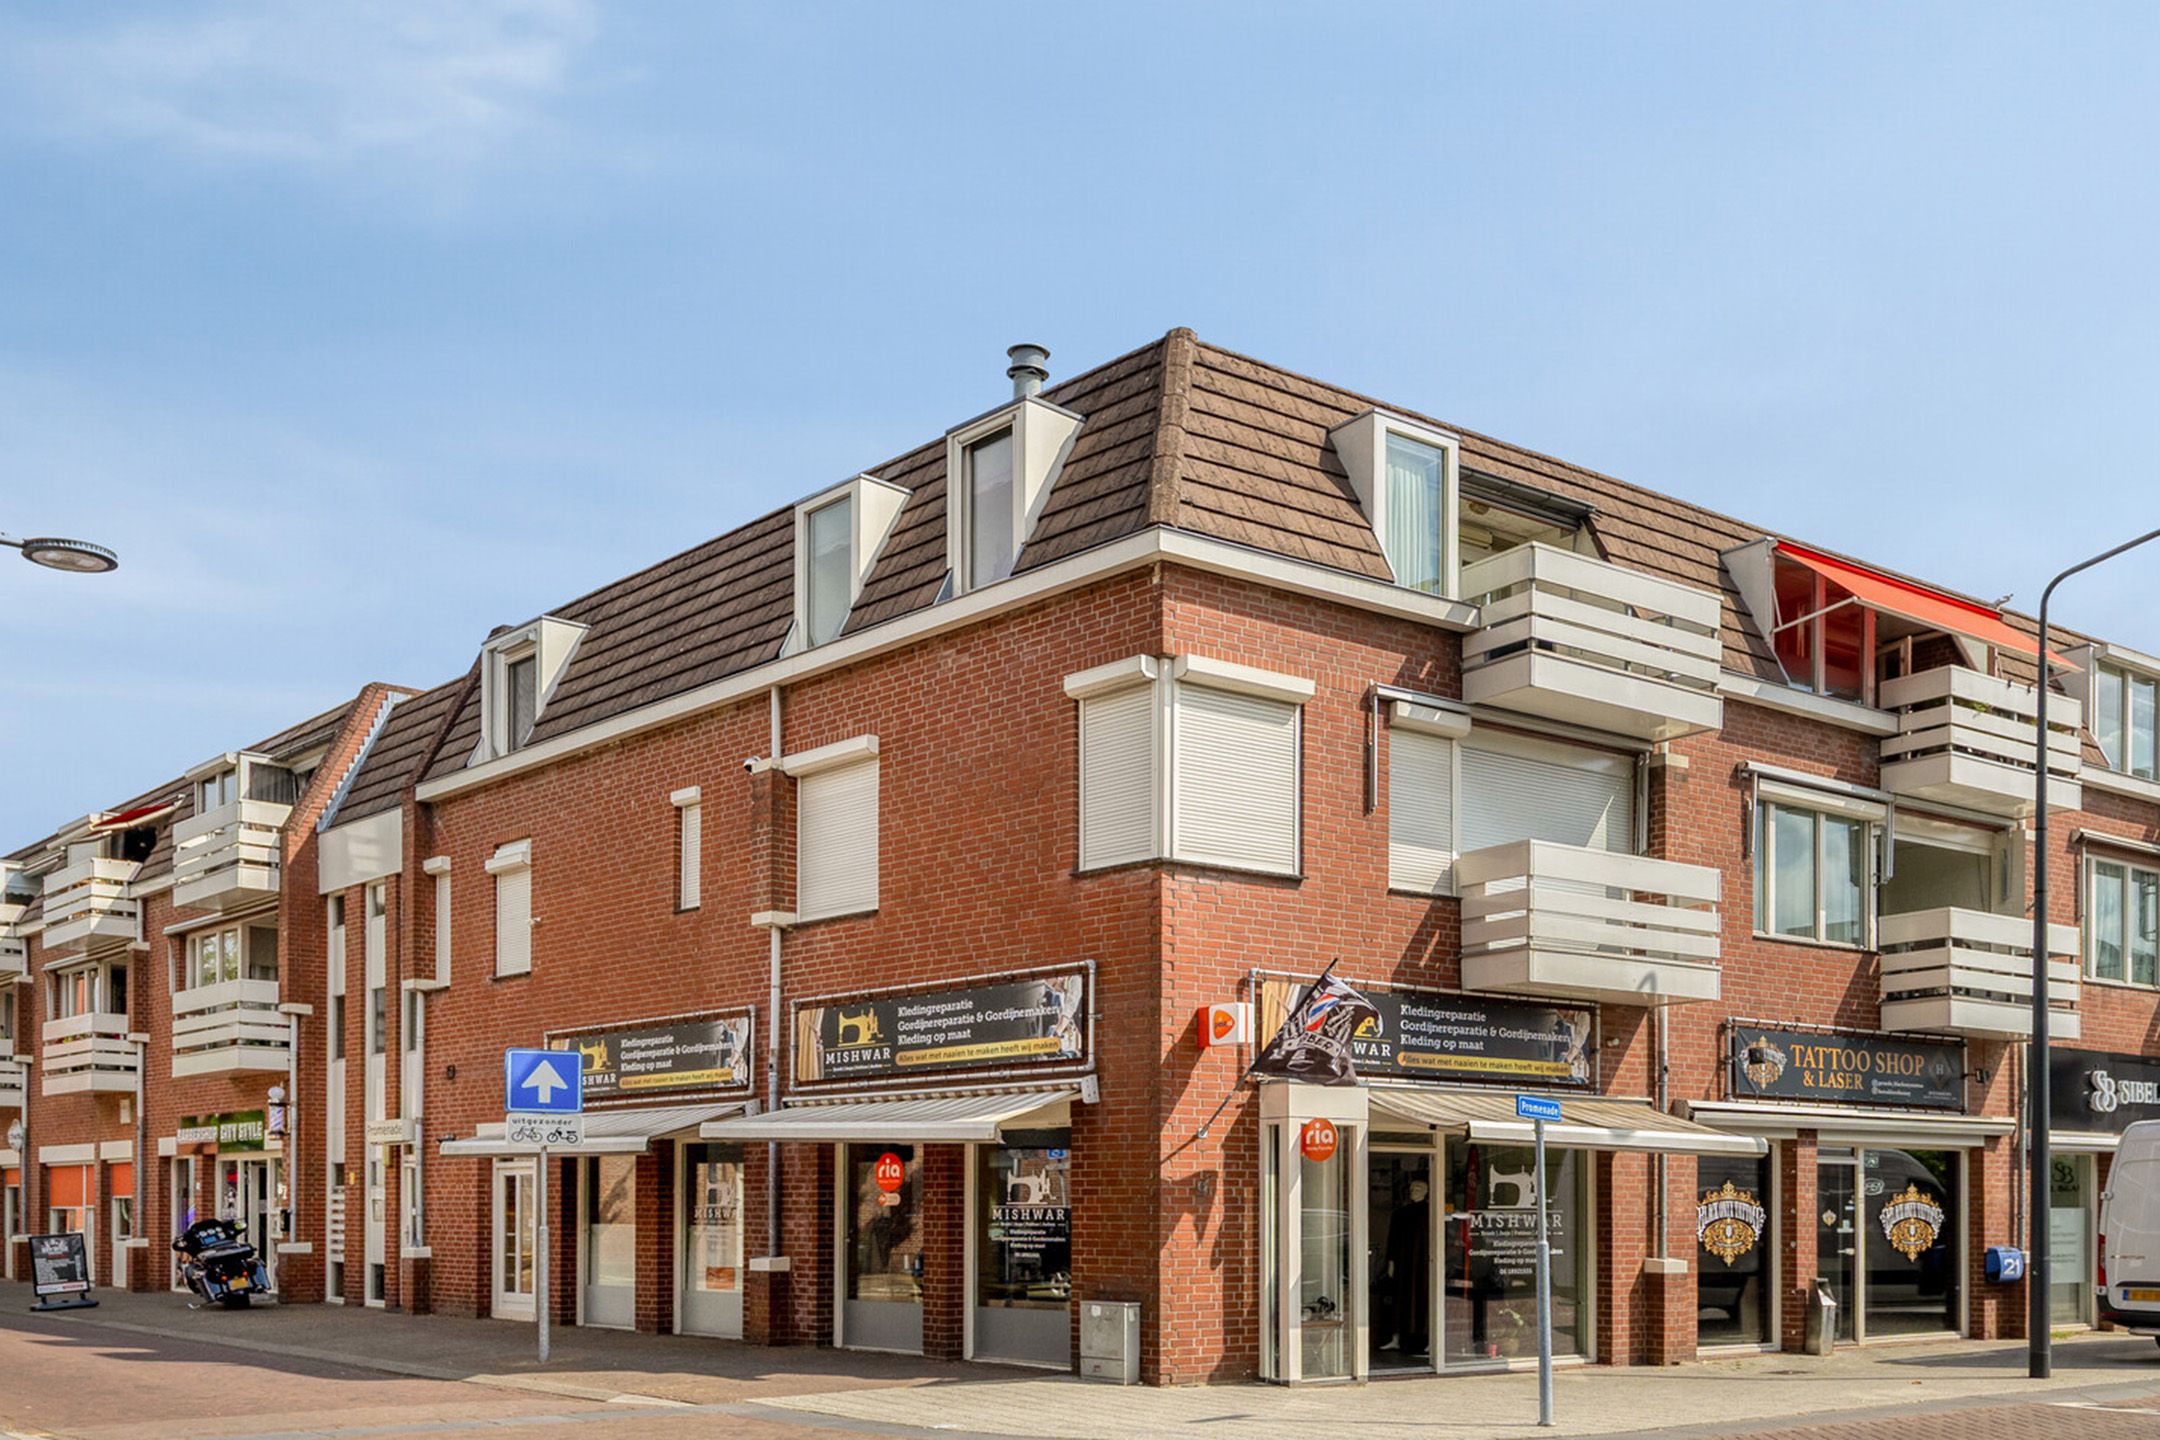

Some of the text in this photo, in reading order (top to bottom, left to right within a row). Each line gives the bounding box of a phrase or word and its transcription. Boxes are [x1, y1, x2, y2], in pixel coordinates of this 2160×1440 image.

[898, 999, 974, 1017] Kledingreparatie
[1400, 1004, 1486, 1023] Kledingreparatie
[897, 1013, 975, 1032] Gordijnereparatie
[976, 1011, 983, 1023] &
[1400, 1019, 1488, 1038] Gordijnereparatie
[1489, 1026, 1497, 1037] &
[898, 1028, 971, 1047] Kleding op maat
[1400, 1034, 1484, 1051] Kleding op maat
[826, 1047, 891, 1065] MISHWAR
[1790, 1044, 1871, 1072] TATTOO
[1875, 1051, 1925, 1076] SHOP
[646, 1061, 654, 1071] op
[582, 1073, 617, 1086] SHWAR
[1803, 1070, 1815, 1087] &
[1818, 1071, 1864, 1090] LASER
[1522, 1100, 1559, 1117] Promenade
[1306, 1122, 1334, 1145] ria
[878, 1158, 900, 1178] ria
[992, 1208, 1065, 1220] MISHWAR
[1470, 1214, 1562, 1228] MISHWR
[2003, 1257, 2020, 1276] 21
